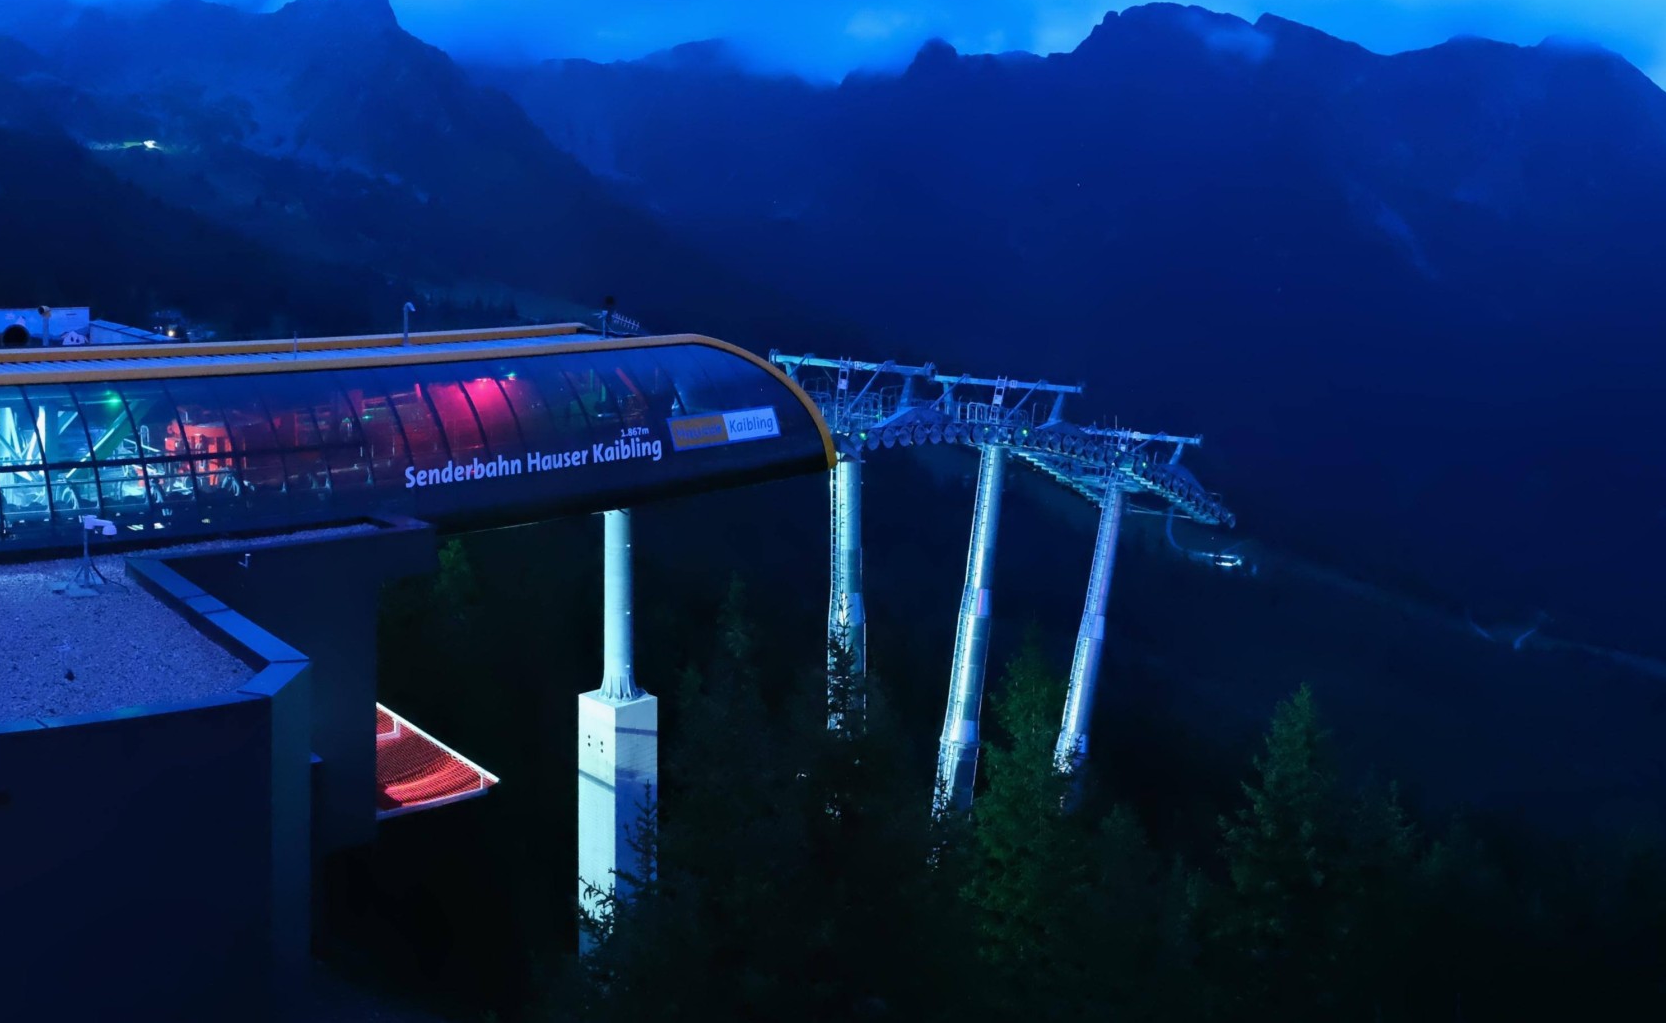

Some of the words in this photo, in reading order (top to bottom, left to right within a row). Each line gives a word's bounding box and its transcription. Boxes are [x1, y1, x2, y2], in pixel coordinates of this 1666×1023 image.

[620, 427, 649, 437] 1.867m
[728, 416, 774, 434] Kaibling
[404, 454, 522, 488] Senderbahn
[527, 449, 588, 473] Hauser
[592, 437, 662, 461] Kaibling
